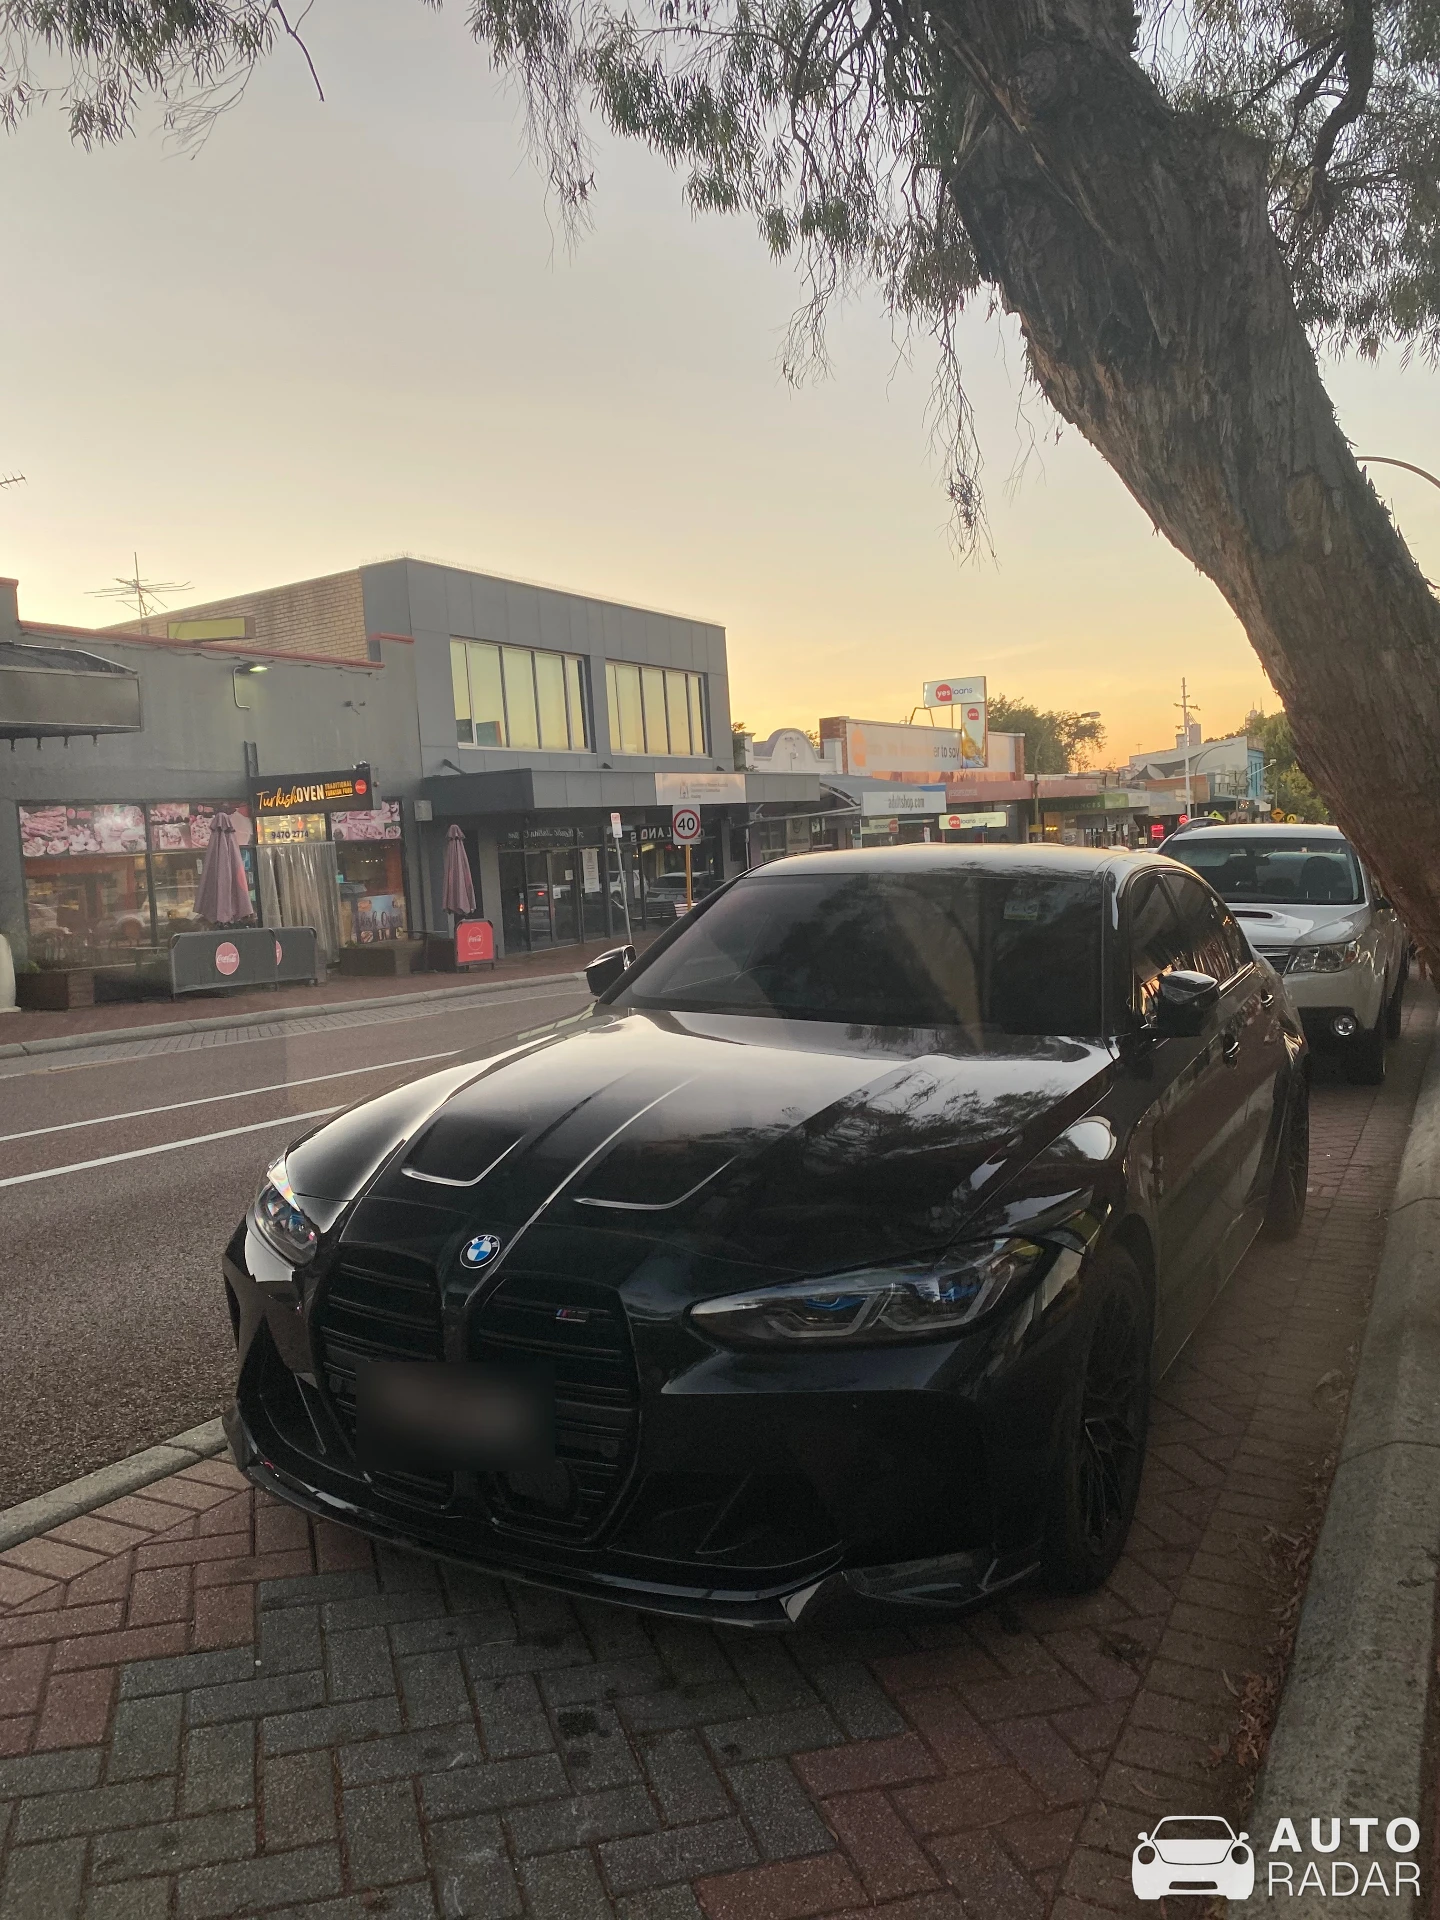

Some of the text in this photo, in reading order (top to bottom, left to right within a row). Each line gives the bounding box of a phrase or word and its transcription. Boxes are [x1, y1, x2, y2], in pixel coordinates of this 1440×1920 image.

[937, 687, 973, 698] yes loans
[948, 747, 960, 761] say
[256, 785, 325, 810] Turkish OVEN
[677, 817, 696, 831] 40
[271, 829, 309, 840] 9470 2774
